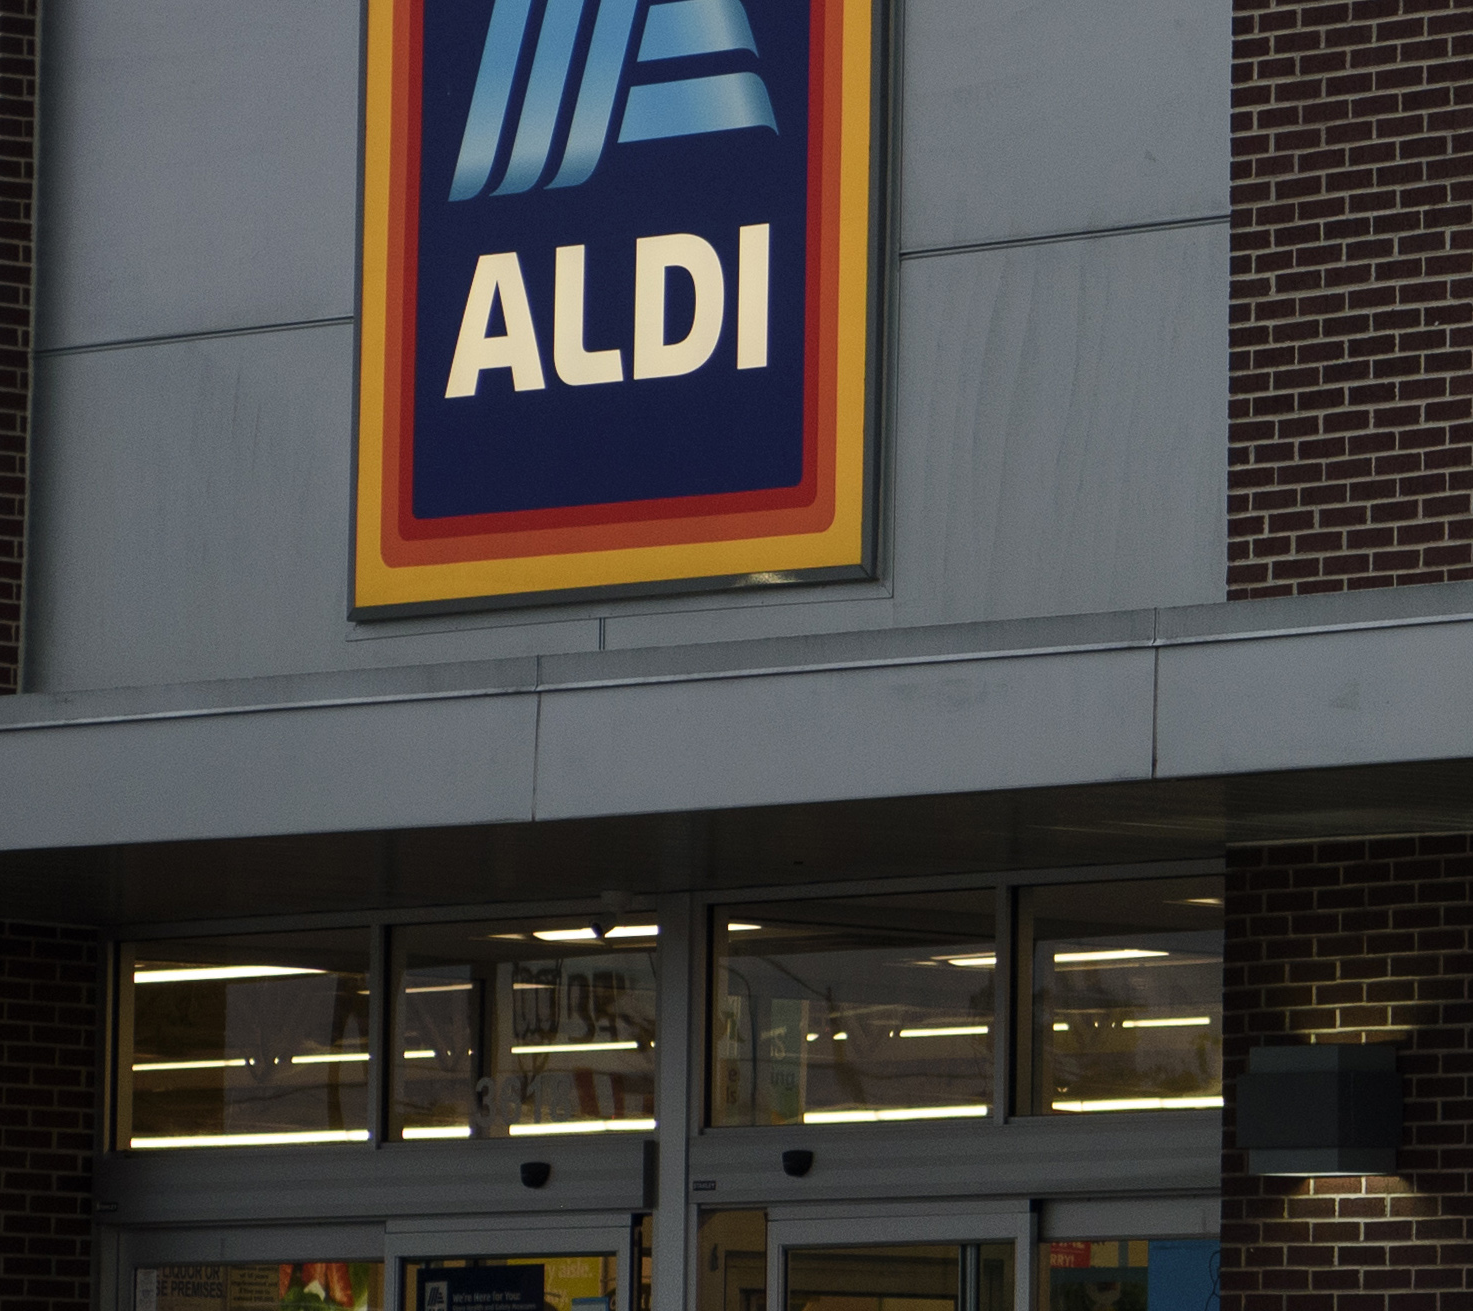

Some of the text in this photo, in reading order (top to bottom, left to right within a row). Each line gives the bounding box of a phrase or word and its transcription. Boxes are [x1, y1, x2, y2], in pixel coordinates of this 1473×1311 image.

[444, 223, 770, 399] ALDI
[162, 1265, 220, 1280] LIQUOR OR
